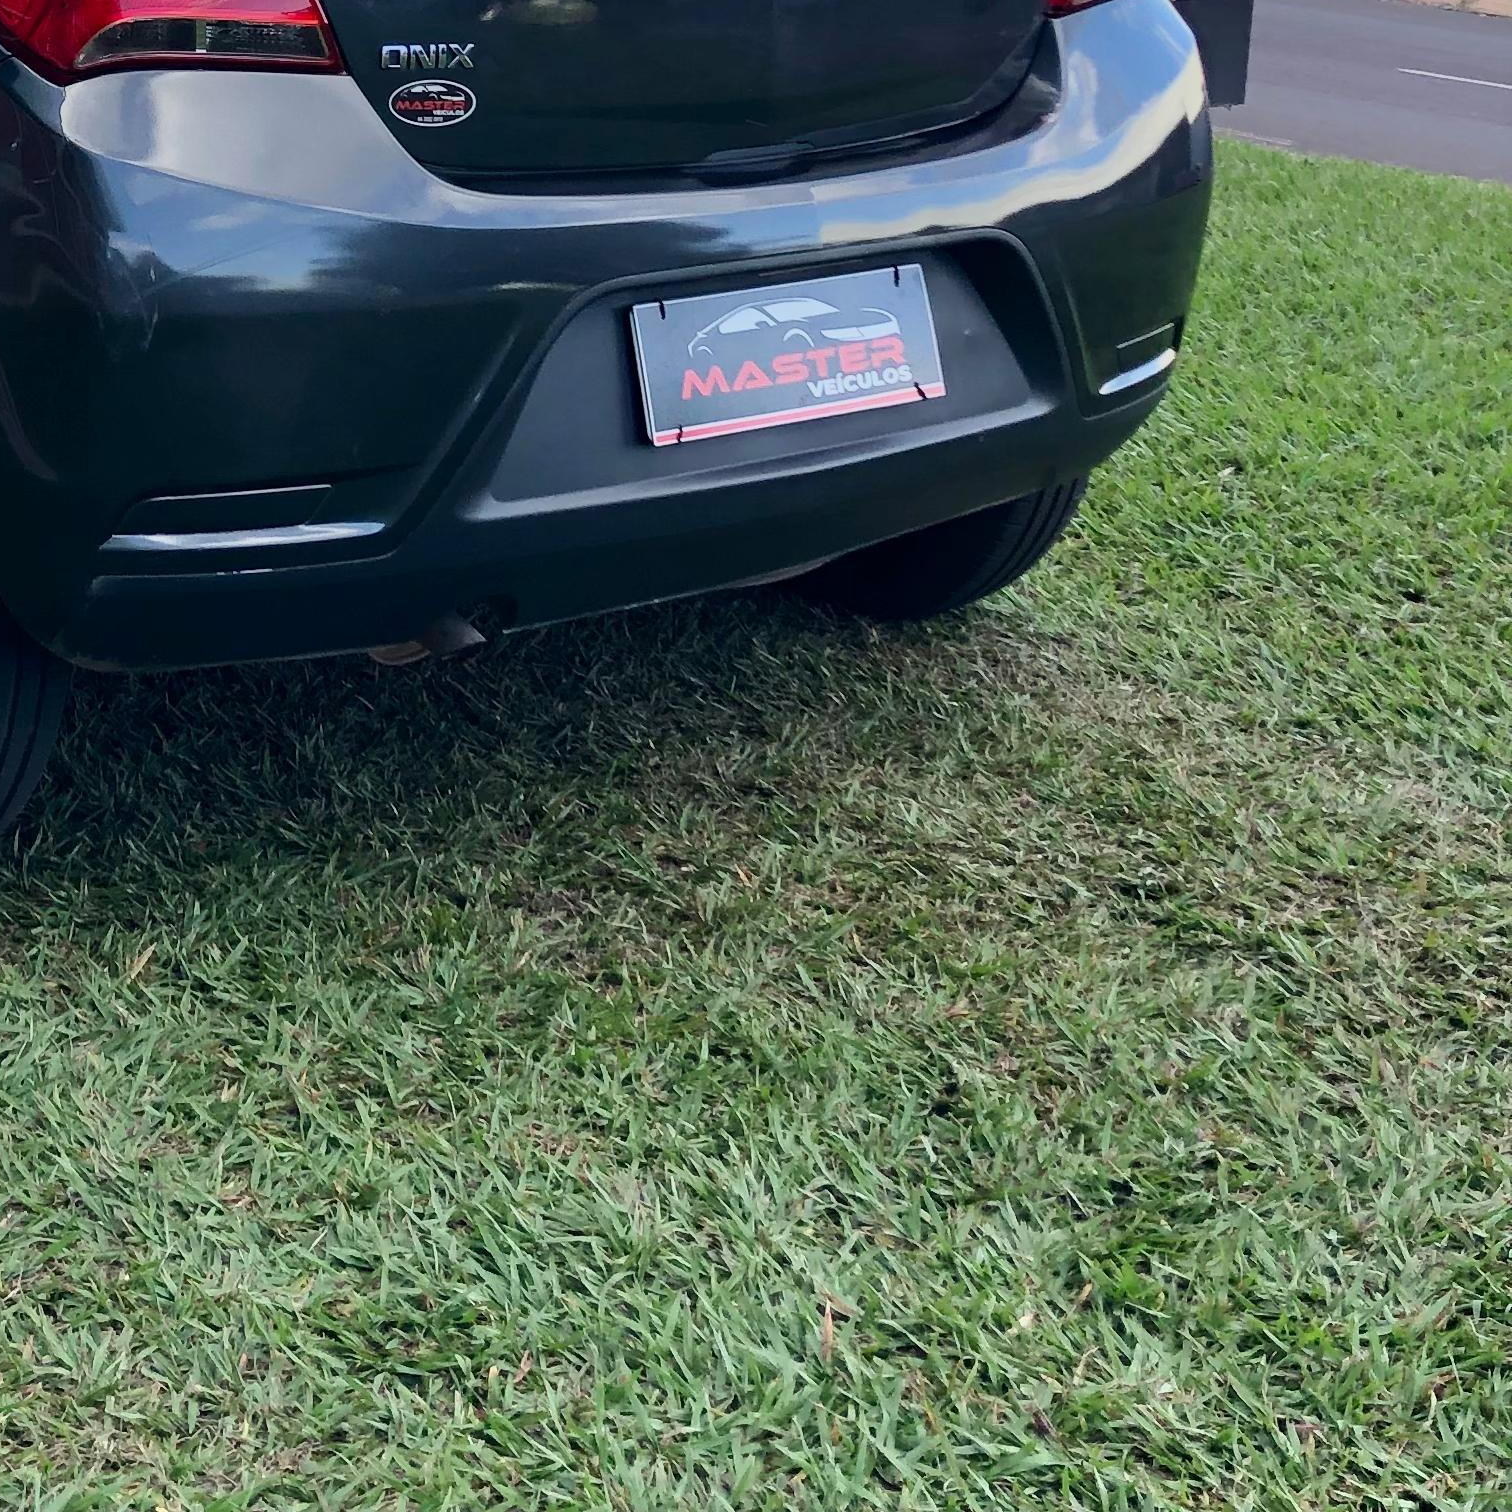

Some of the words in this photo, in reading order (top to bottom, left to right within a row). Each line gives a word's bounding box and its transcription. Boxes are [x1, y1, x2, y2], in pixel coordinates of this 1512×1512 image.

[381, 43, 475, 69] ONIX
[395, 100, 465, 111] MASTER
[681, 335, 906, 402] MASTER
[806, 364, 914, 399] VEÍCULOS
